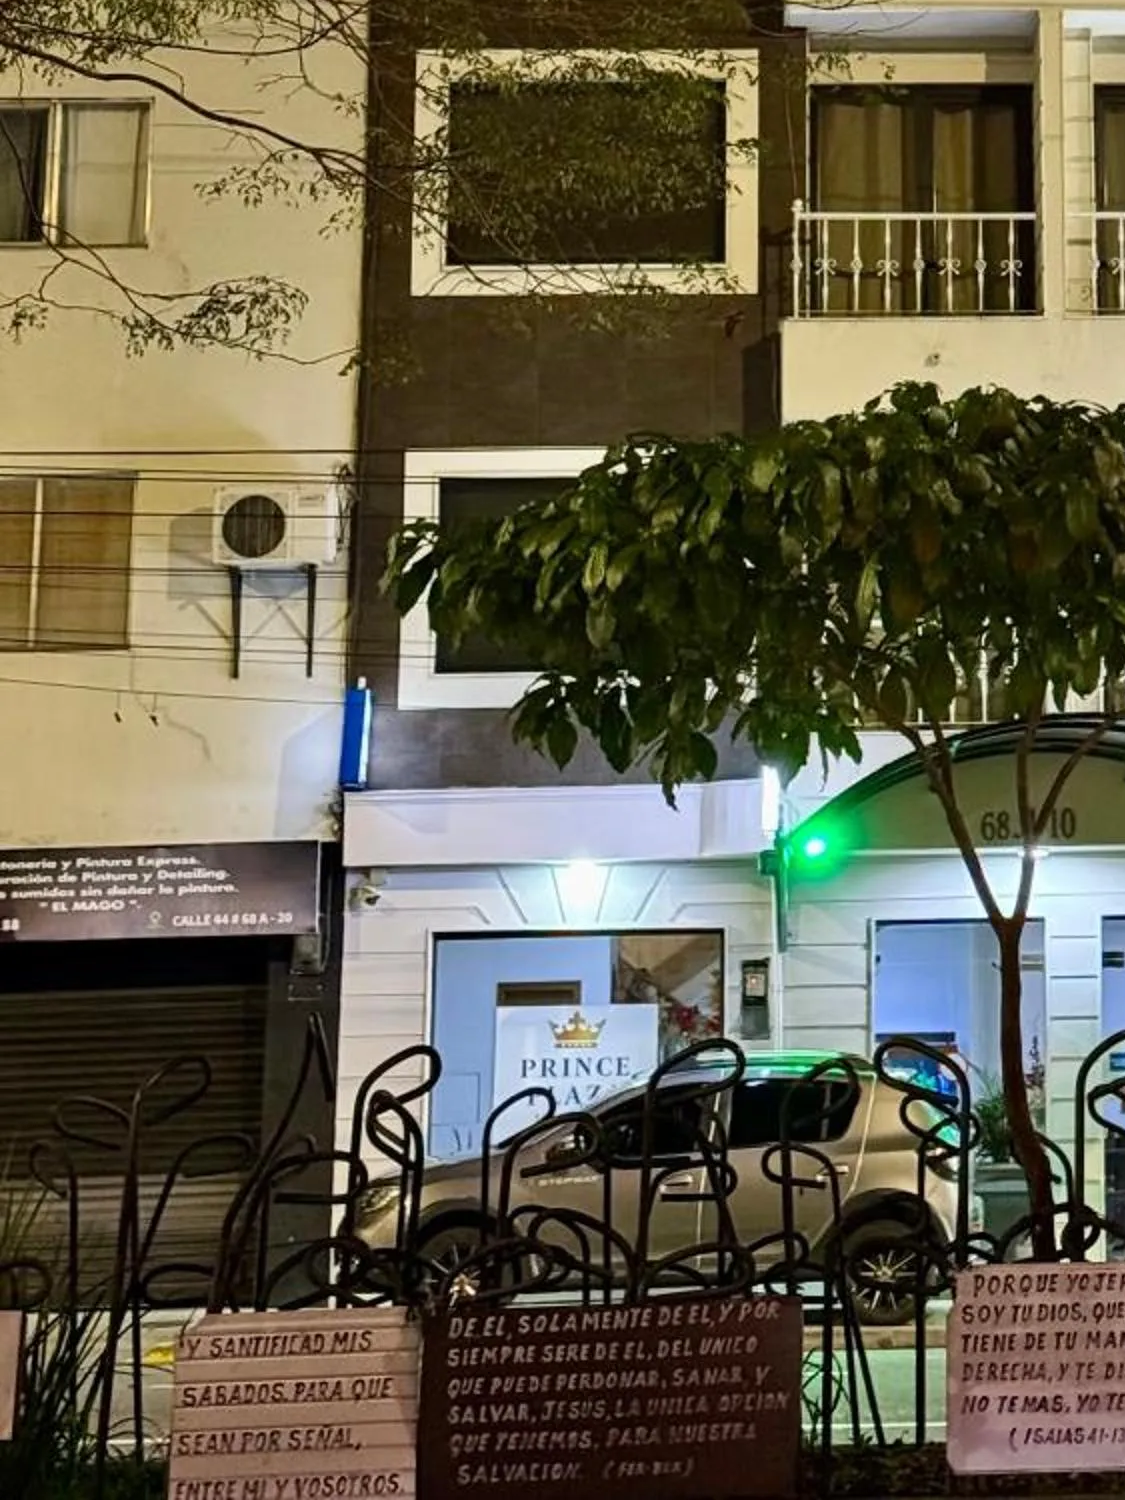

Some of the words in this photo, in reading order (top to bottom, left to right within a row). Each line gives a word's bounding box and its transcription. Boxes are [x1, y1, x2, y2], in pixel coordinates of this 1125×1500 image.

[63, 861, 71, 870] y
[77, 857, 132, 868] Pintura
[58, 872, 77, 882] de
[82, 870, 137, 882] Pintura
[143, 873, 150, 882] y
[81, 885, 102, 897] sin
[172, 915, 212, 927] CALLE
[521, 1057, 630, 1078] PRINCE
[973, 1274, 1059, 1298] PORQUE
[1067, 1273, 1090, 1293] YO
[449, 1318, 478, 1339] DE
[518, 1308, 652, 1333] SOLAMENTE
[658, 1305, 683, 1326] DE
[718, 1303, 733, 1322] Y
[738, 1301, 781, 1322] POR
[962, 1305, 1006, 1324] SOY
[1011, 1304, 1033, 1322] TU
[1092, 1301, 1125, 1323] QUE
[210, 1334, 325, 1358] SANTIFICAD
[330, 1330, 372, 1352] MIS
[448, 1346, 536, 1367] SIEMPRE
[542, 1344, 590, 1363] SERE
[594, 1343, 620, 1360] DE
[658, 1339, 693, 1359] DEL
[699, 1336, 758, 1355] UNICO
[961, 1333, 1016, 1353] TIENE
[1024, 1332, 1046, 1349] DE
[1055, 1331, 1077, 1349] TU
[448, 1378, 485, 1399] QUE
[490, 1375, 551, 1395] PUEDE
[756, 1366, 772, 1385] Y
[1058, 1364, 1068, 1381] Y
[1076, 1362, 1094, 1379] TE
[293, 1380, 342, 1401] PARA
[351, 1377, 393, 1404] QUE
[615, 1398, 641, 1418] LA
[961, 1396, 989, 1414] NO
[1077, 1394, 1101, 1413] YO
[178, 1433, 235, 1455] SEAN
[241, 1430, 282, 1453] POR
[451, 1433, 491, 1457] QUE
[606, 1427, 661, 1447] PARA
[274, 1479, 288, 1500] Y
